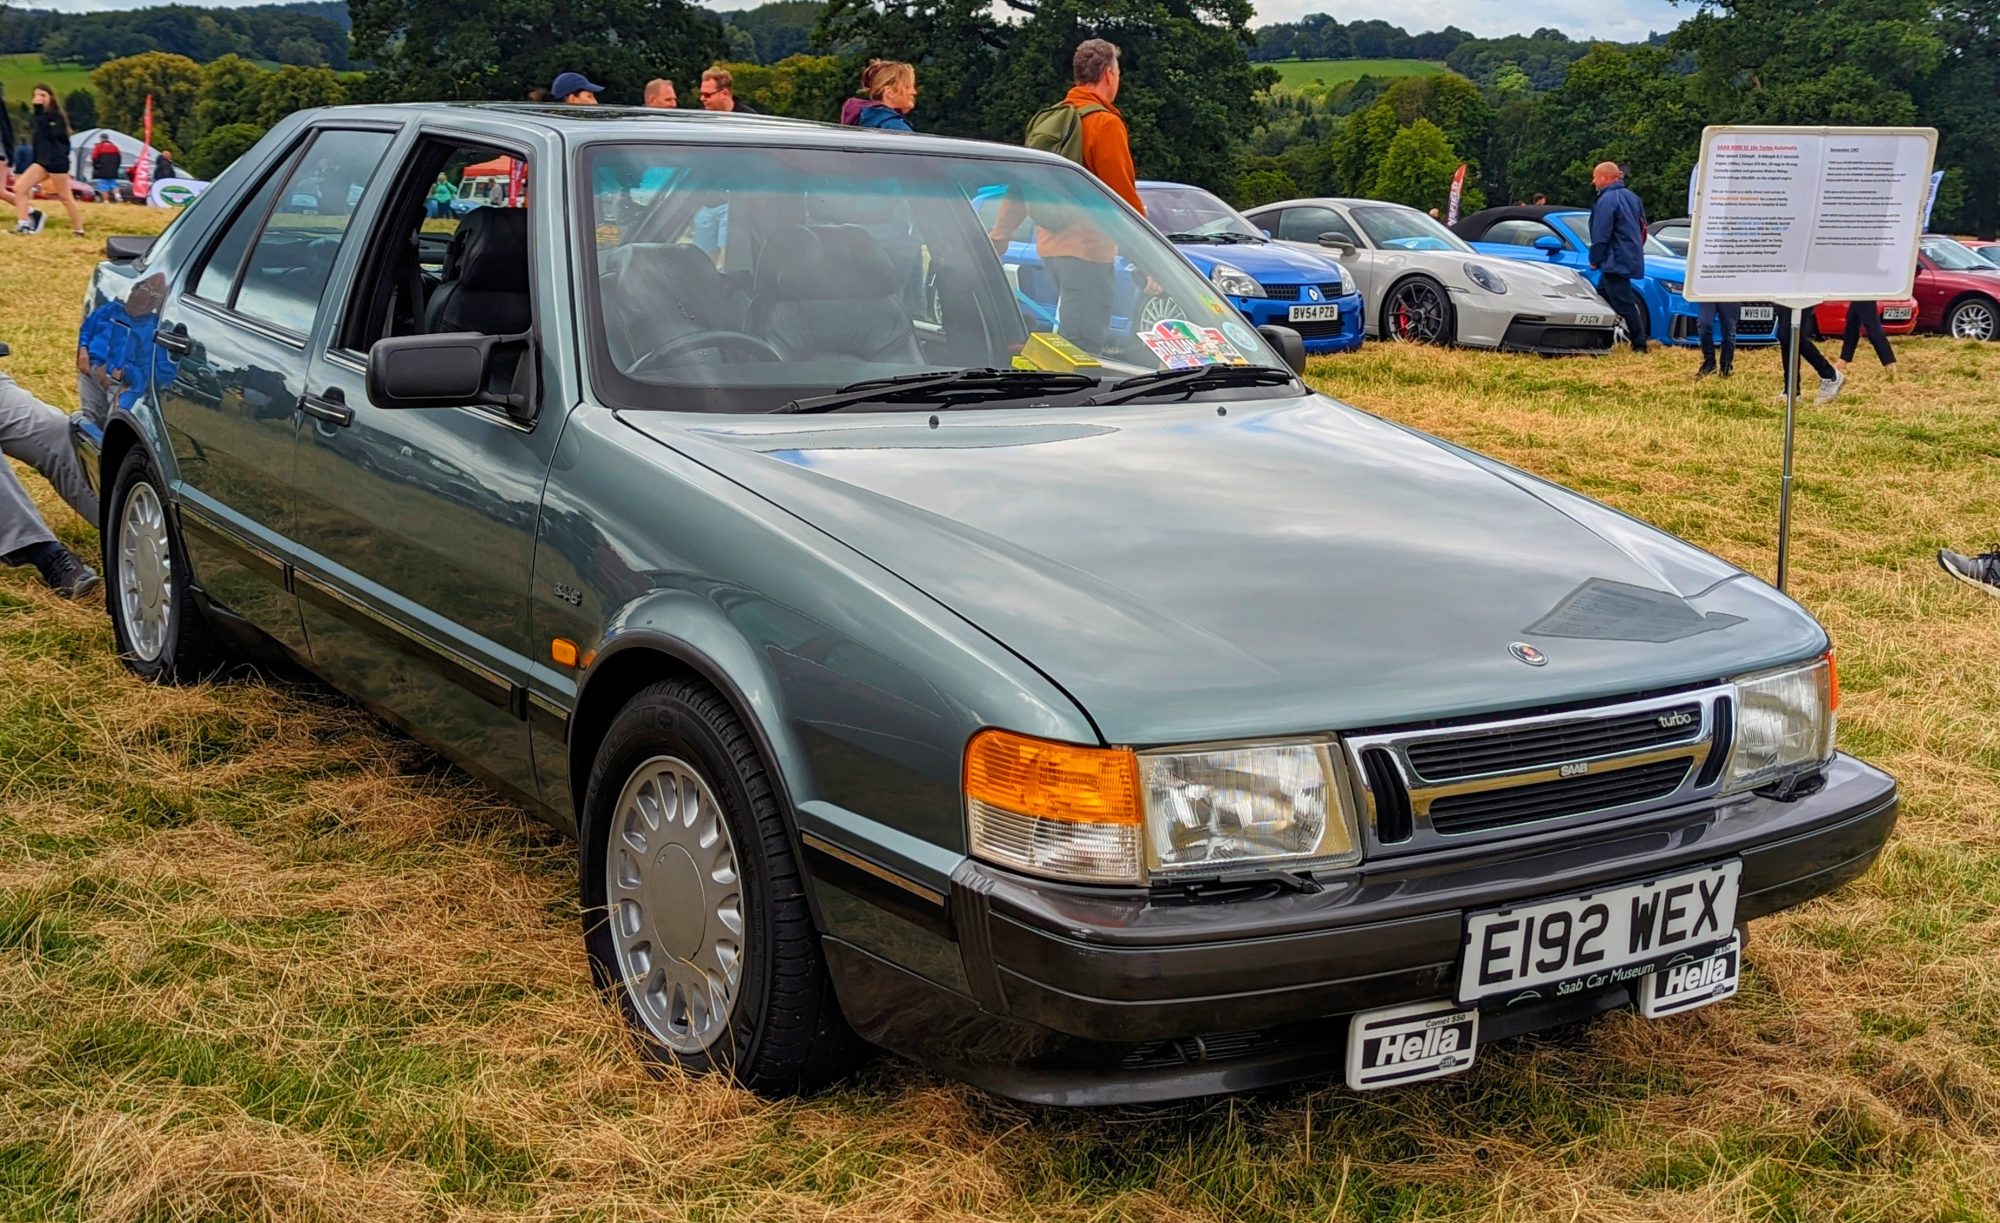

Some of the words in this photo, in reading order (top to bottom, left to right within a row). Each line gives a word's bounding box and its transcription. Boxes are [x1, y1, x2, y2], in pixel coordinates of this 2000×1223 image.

[1293, 308, 1317, 319] BV54
[1319, 306, 1335, 318] PZB
[1658, 711, 1692, 728] turbo
[1560, 762, 1588, 777] SAAB
[1478, 903, 1610, 986] E192
[1628, 874, 1726, 955] WEX
[1556, 981, 1583, 996] Saab
[1586, 974, 1608, 989] Car
[1609, 963, 1655, 983] Museum
[1665, 957, 1728, 996] Hella
[1375, 1026, 1460, 1067] Hella
